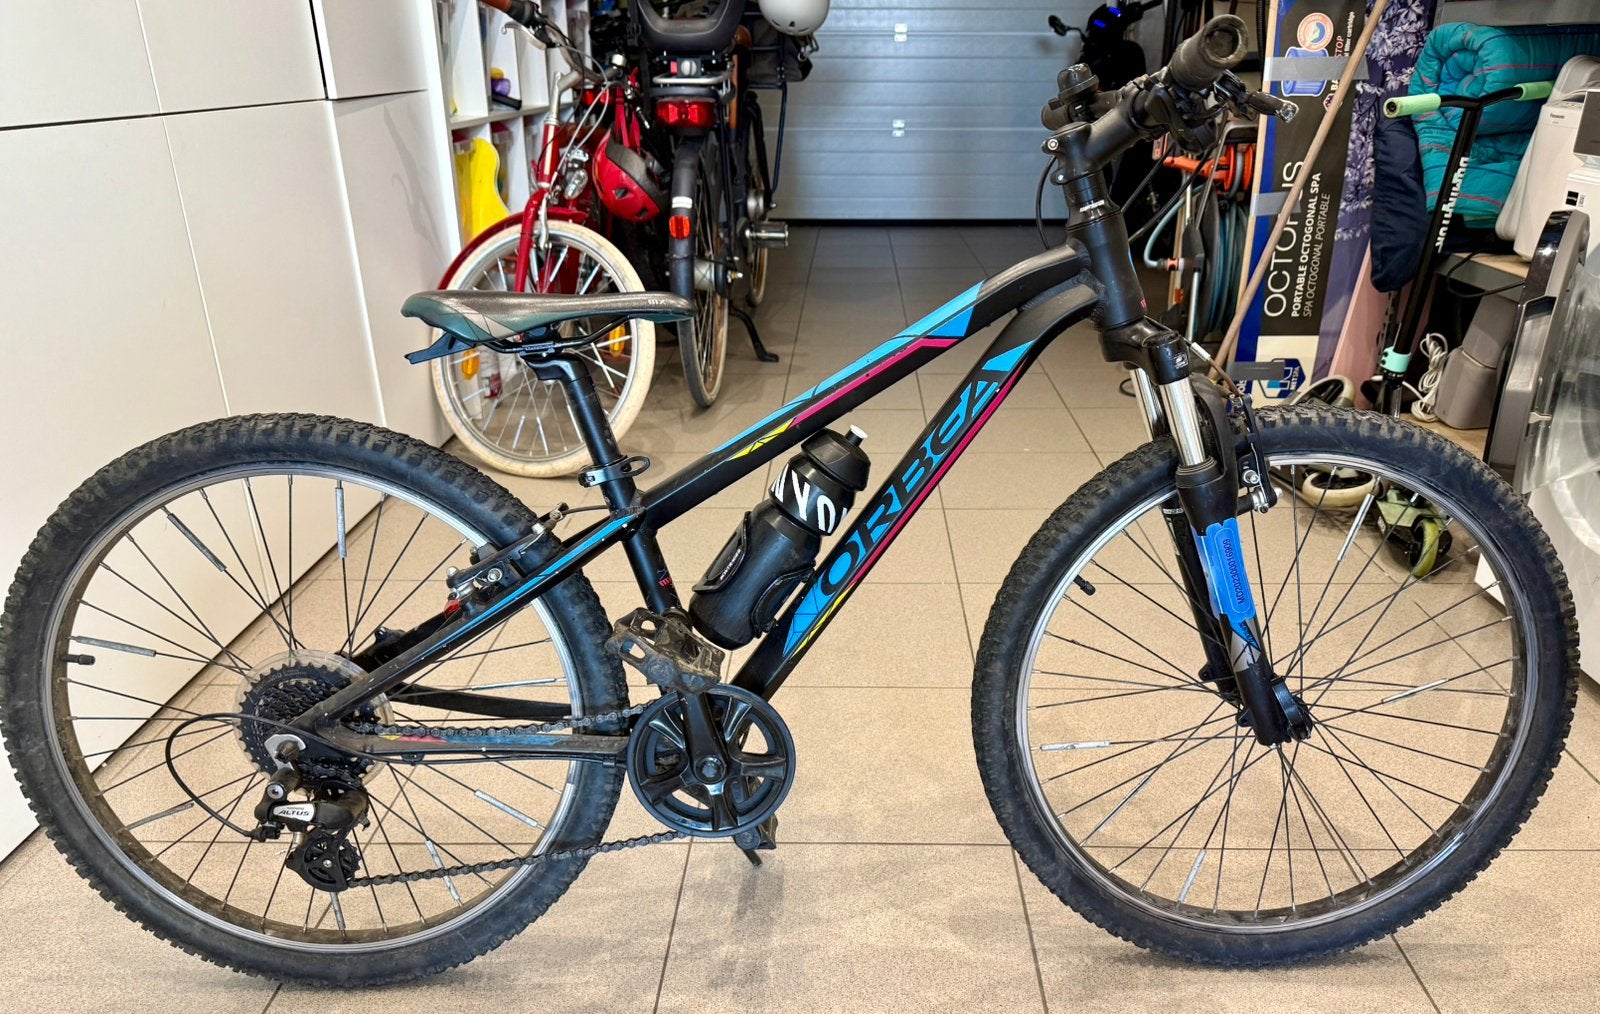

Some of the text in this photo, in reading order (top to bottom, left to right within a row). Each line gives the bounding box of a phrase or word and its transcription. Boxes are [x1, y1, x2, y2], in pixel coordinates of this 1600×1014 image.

[1291, 172, 1322, 318] PORTABLE OCTOGONAL SPA
[1302, 192, 1331, 318] SPA OCTOGONAL PORTABLE
[819, 378, 999, 597] ORBEA
